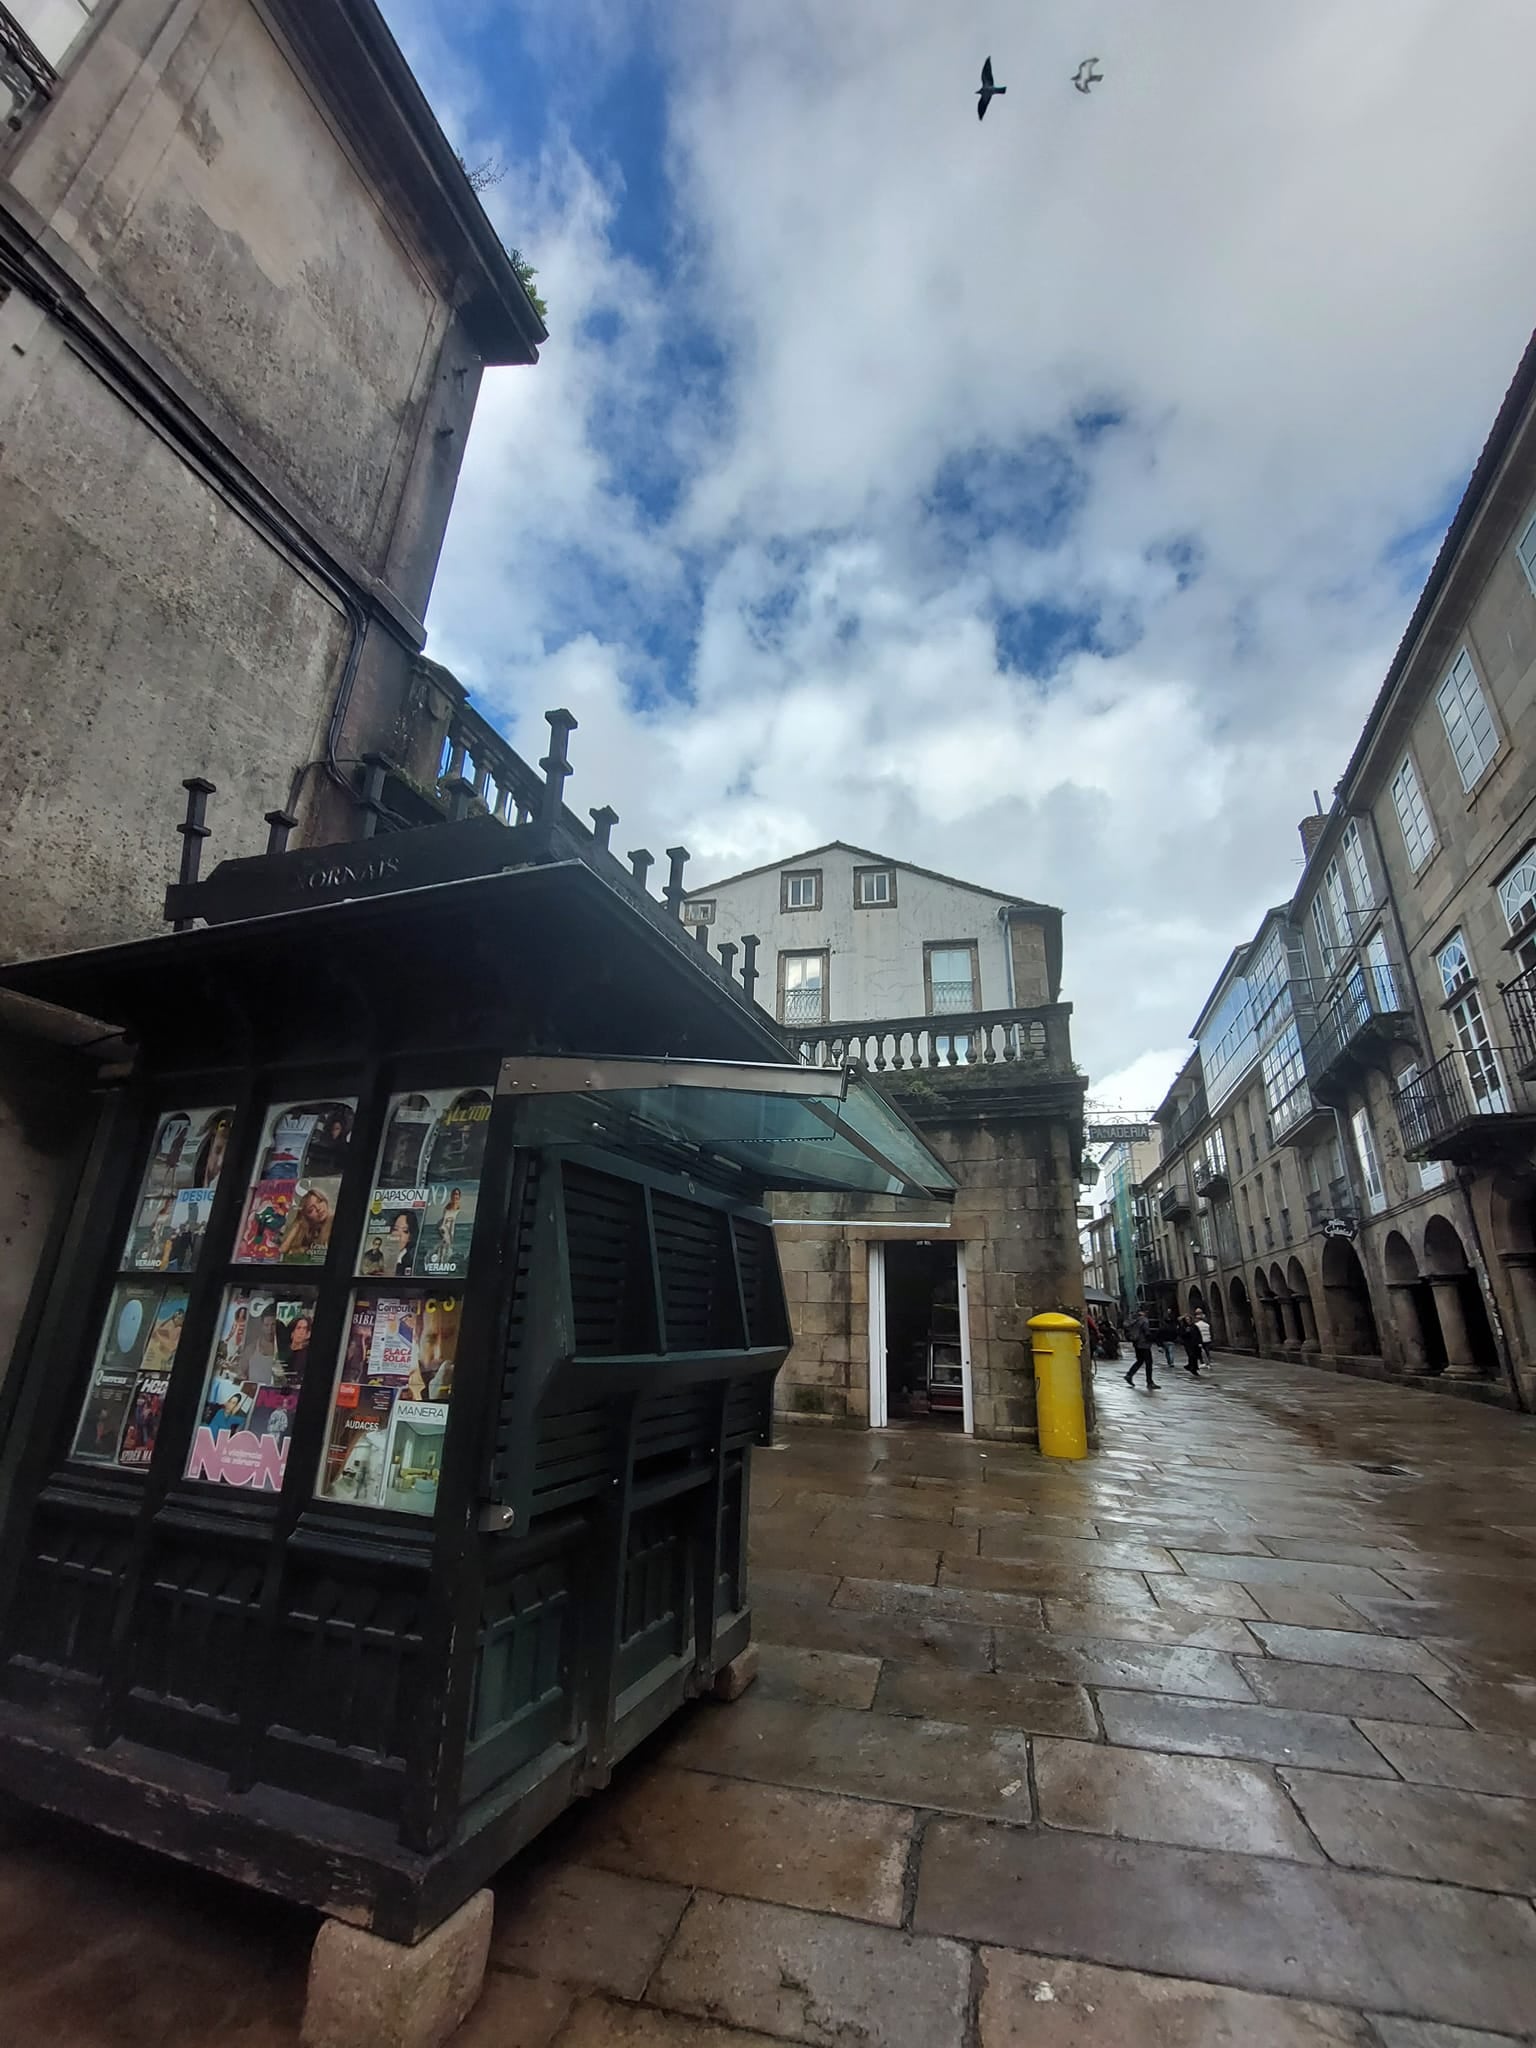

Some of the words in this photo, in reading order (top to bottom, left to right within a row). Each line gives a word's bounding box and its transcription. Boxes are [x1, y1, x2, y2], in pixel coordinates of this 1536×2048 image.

[1090, 1126, 1148, 1139] PANADERIA
[374, 1189, 425, 1201] DIAPASON
[135, 1259, 161, 1267] VERANO
[424, 1263, 456, 1272] VERANO
[397, 1405, 445, 1419] MANERA
[344, 1419, 379, 1431] AUDACES
[187, 1426, 291, 1492] NON
